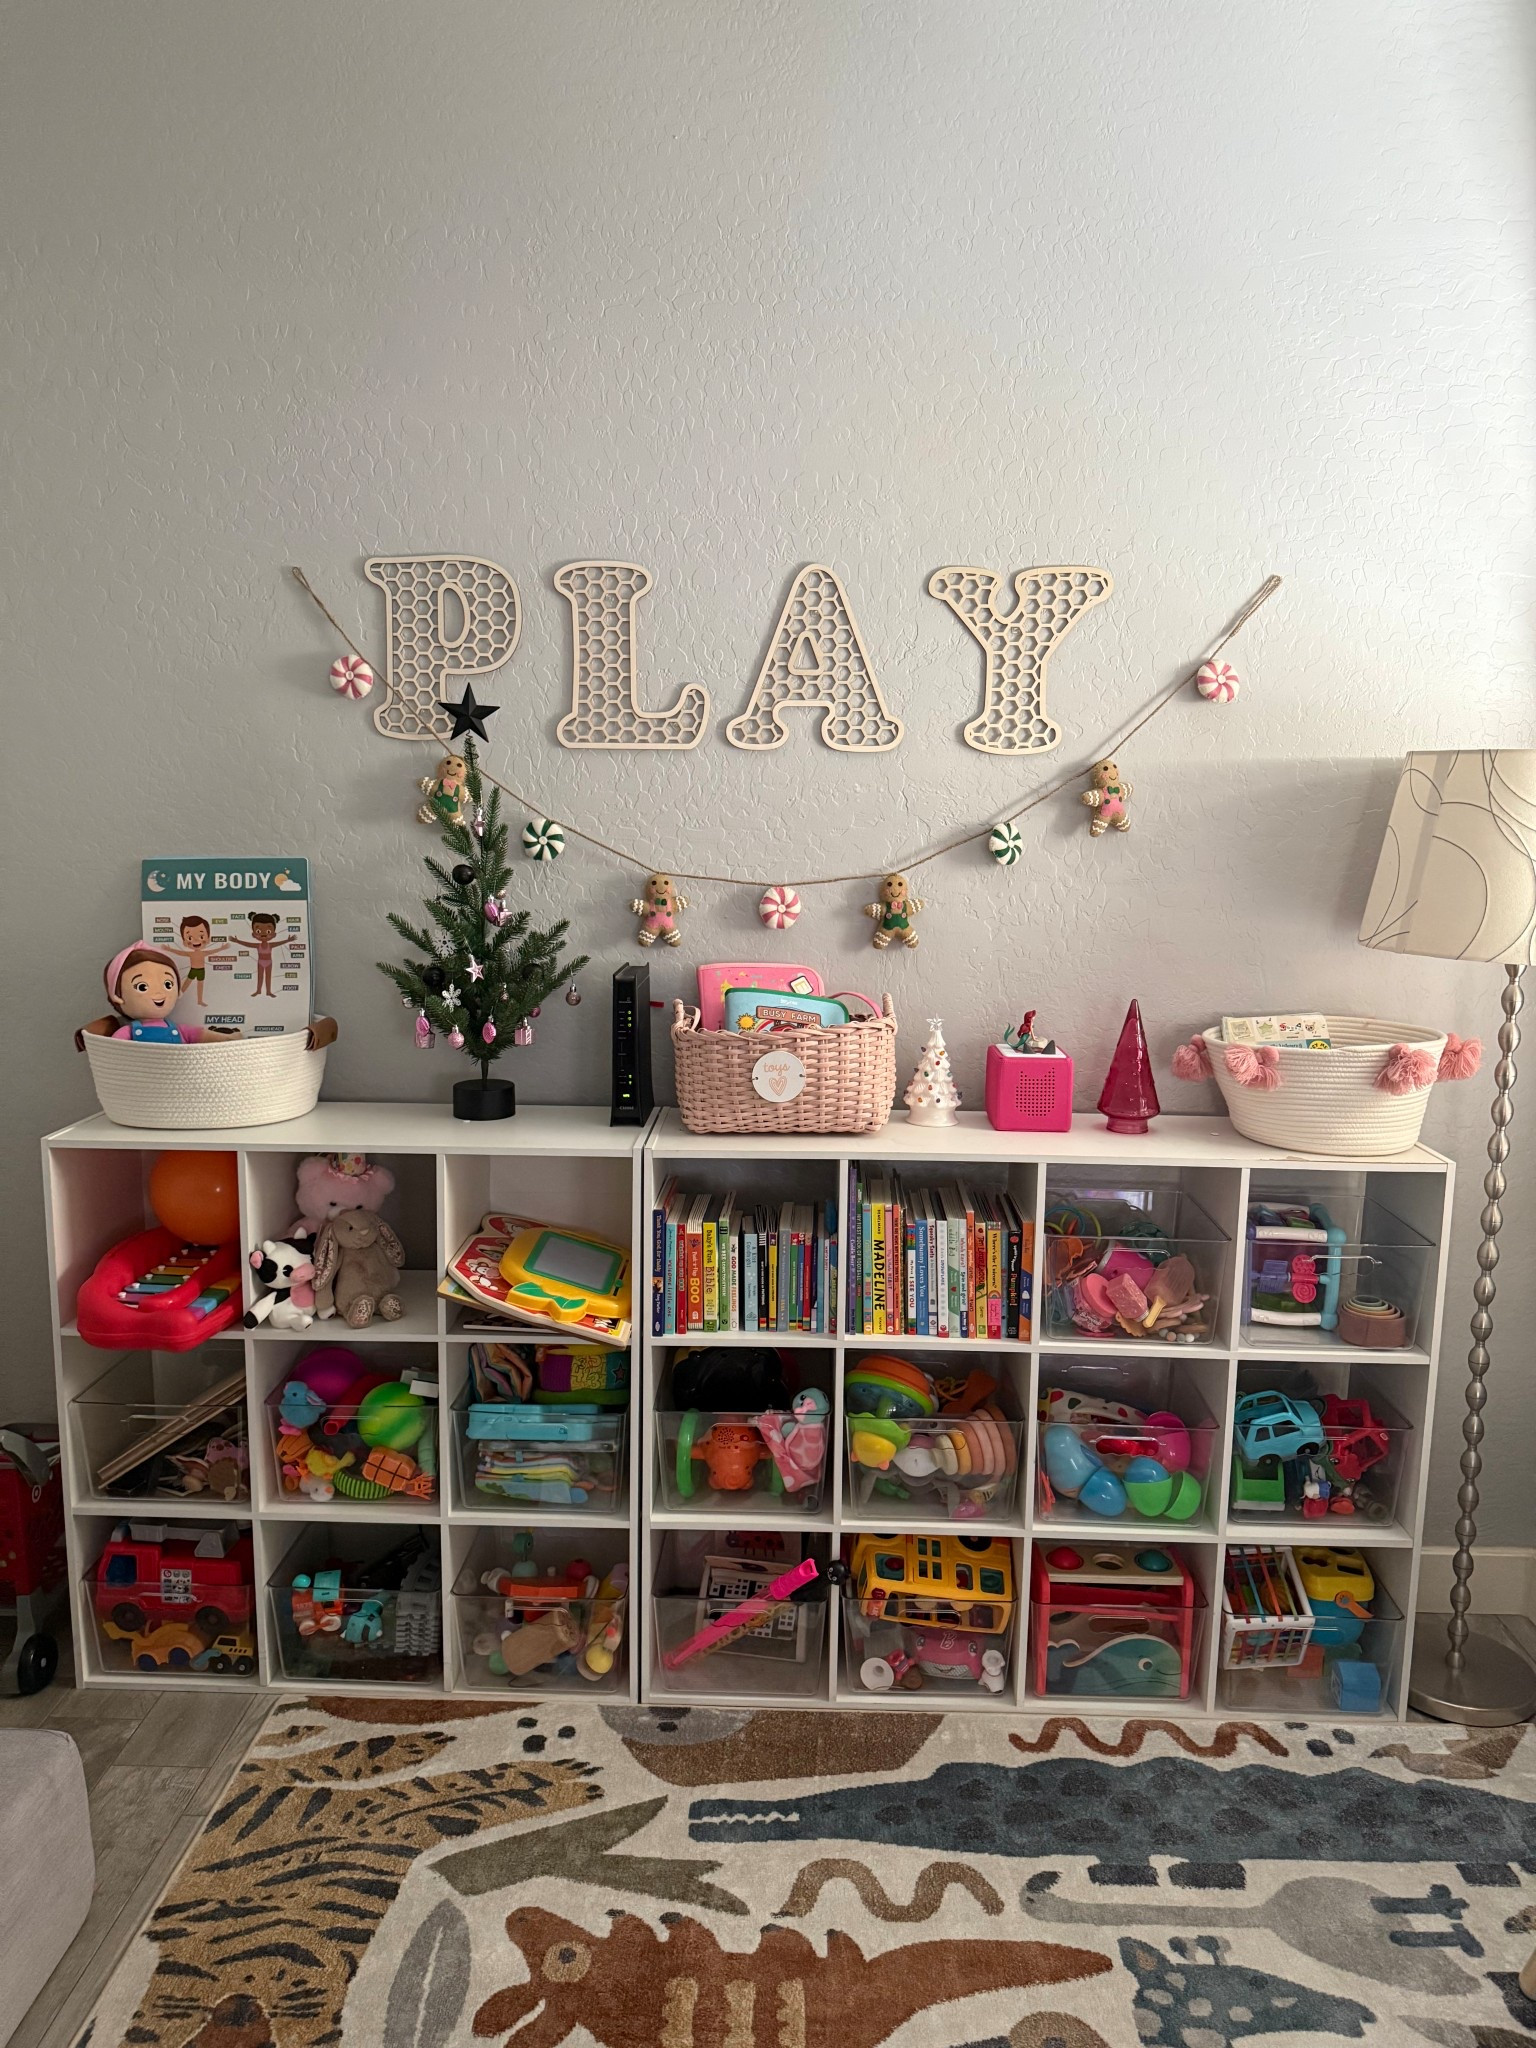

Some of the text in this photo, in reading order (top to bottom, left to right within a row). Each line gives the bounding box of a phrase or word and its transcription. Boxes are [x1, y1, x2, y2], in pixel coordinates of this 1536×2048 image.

[364, 556, 1114, 755] PLAY
[176, 872, 272, 890] MY BODY
[763, 1009, 817, 1022] BUSY FARM
[763, 1062, 790, 1077] toys
[917, 1226, 926, 1264] Somebunny
[705, 1266, 715, 1294] Bible
[874, 1239, 885, 1311] MADELINE
[690, 1277, 700, 1304] BOO
[1009, 1273, 1018, 1306] Pumpkin!
